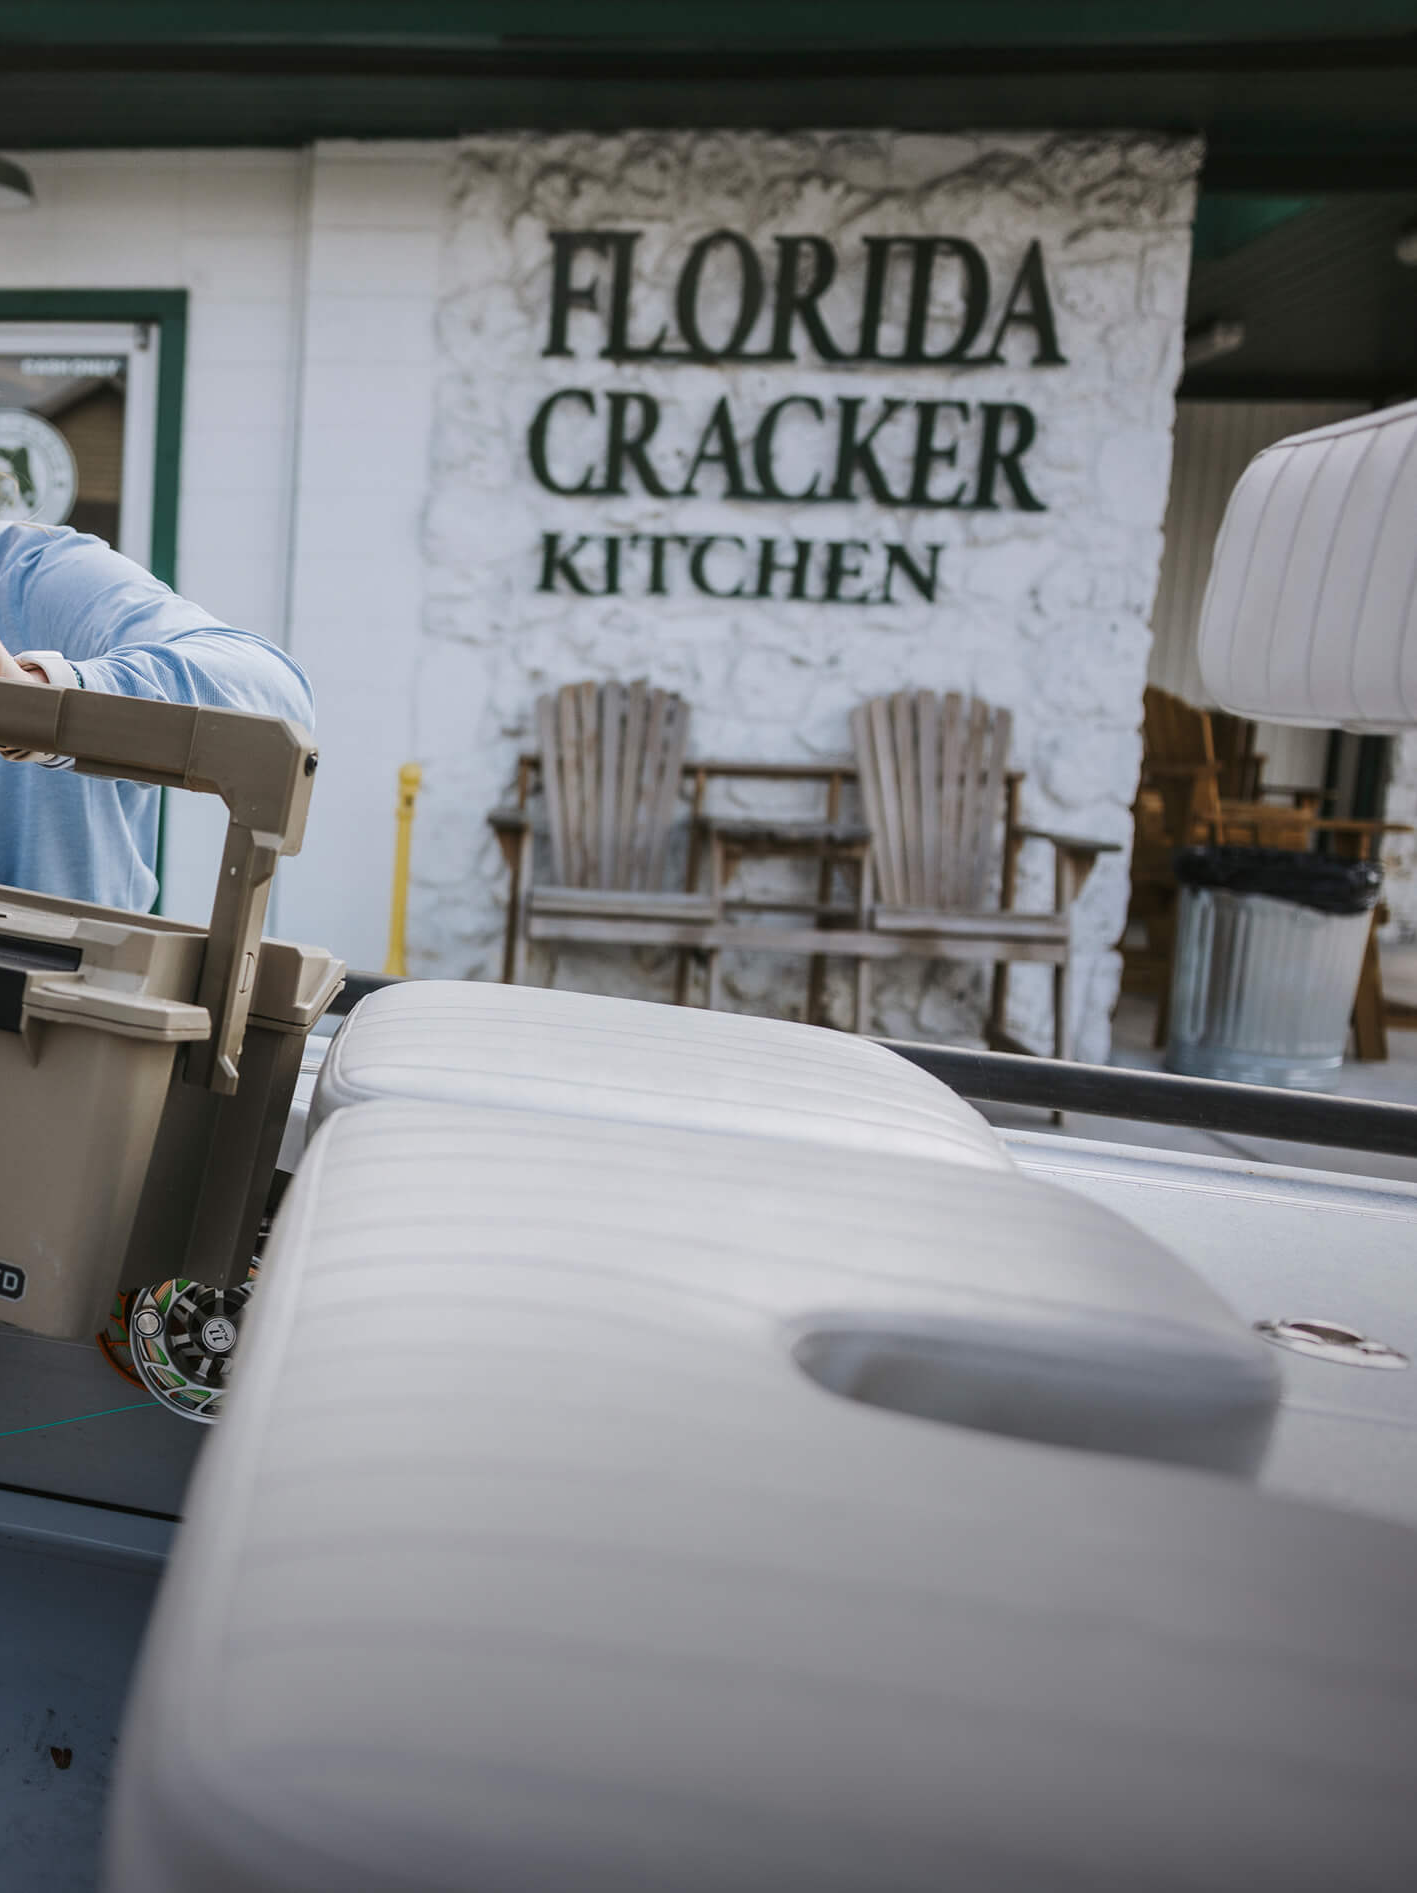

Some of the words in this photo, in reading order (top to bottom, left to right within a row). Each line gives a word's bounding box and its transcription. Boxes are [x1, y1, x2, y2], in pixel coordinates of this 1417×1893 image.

[541, 229, 1068, 367] FLORIDA
[527, 388, 1049, 512] CRACKER
[536, 531, 948, 604] KITCHEN
